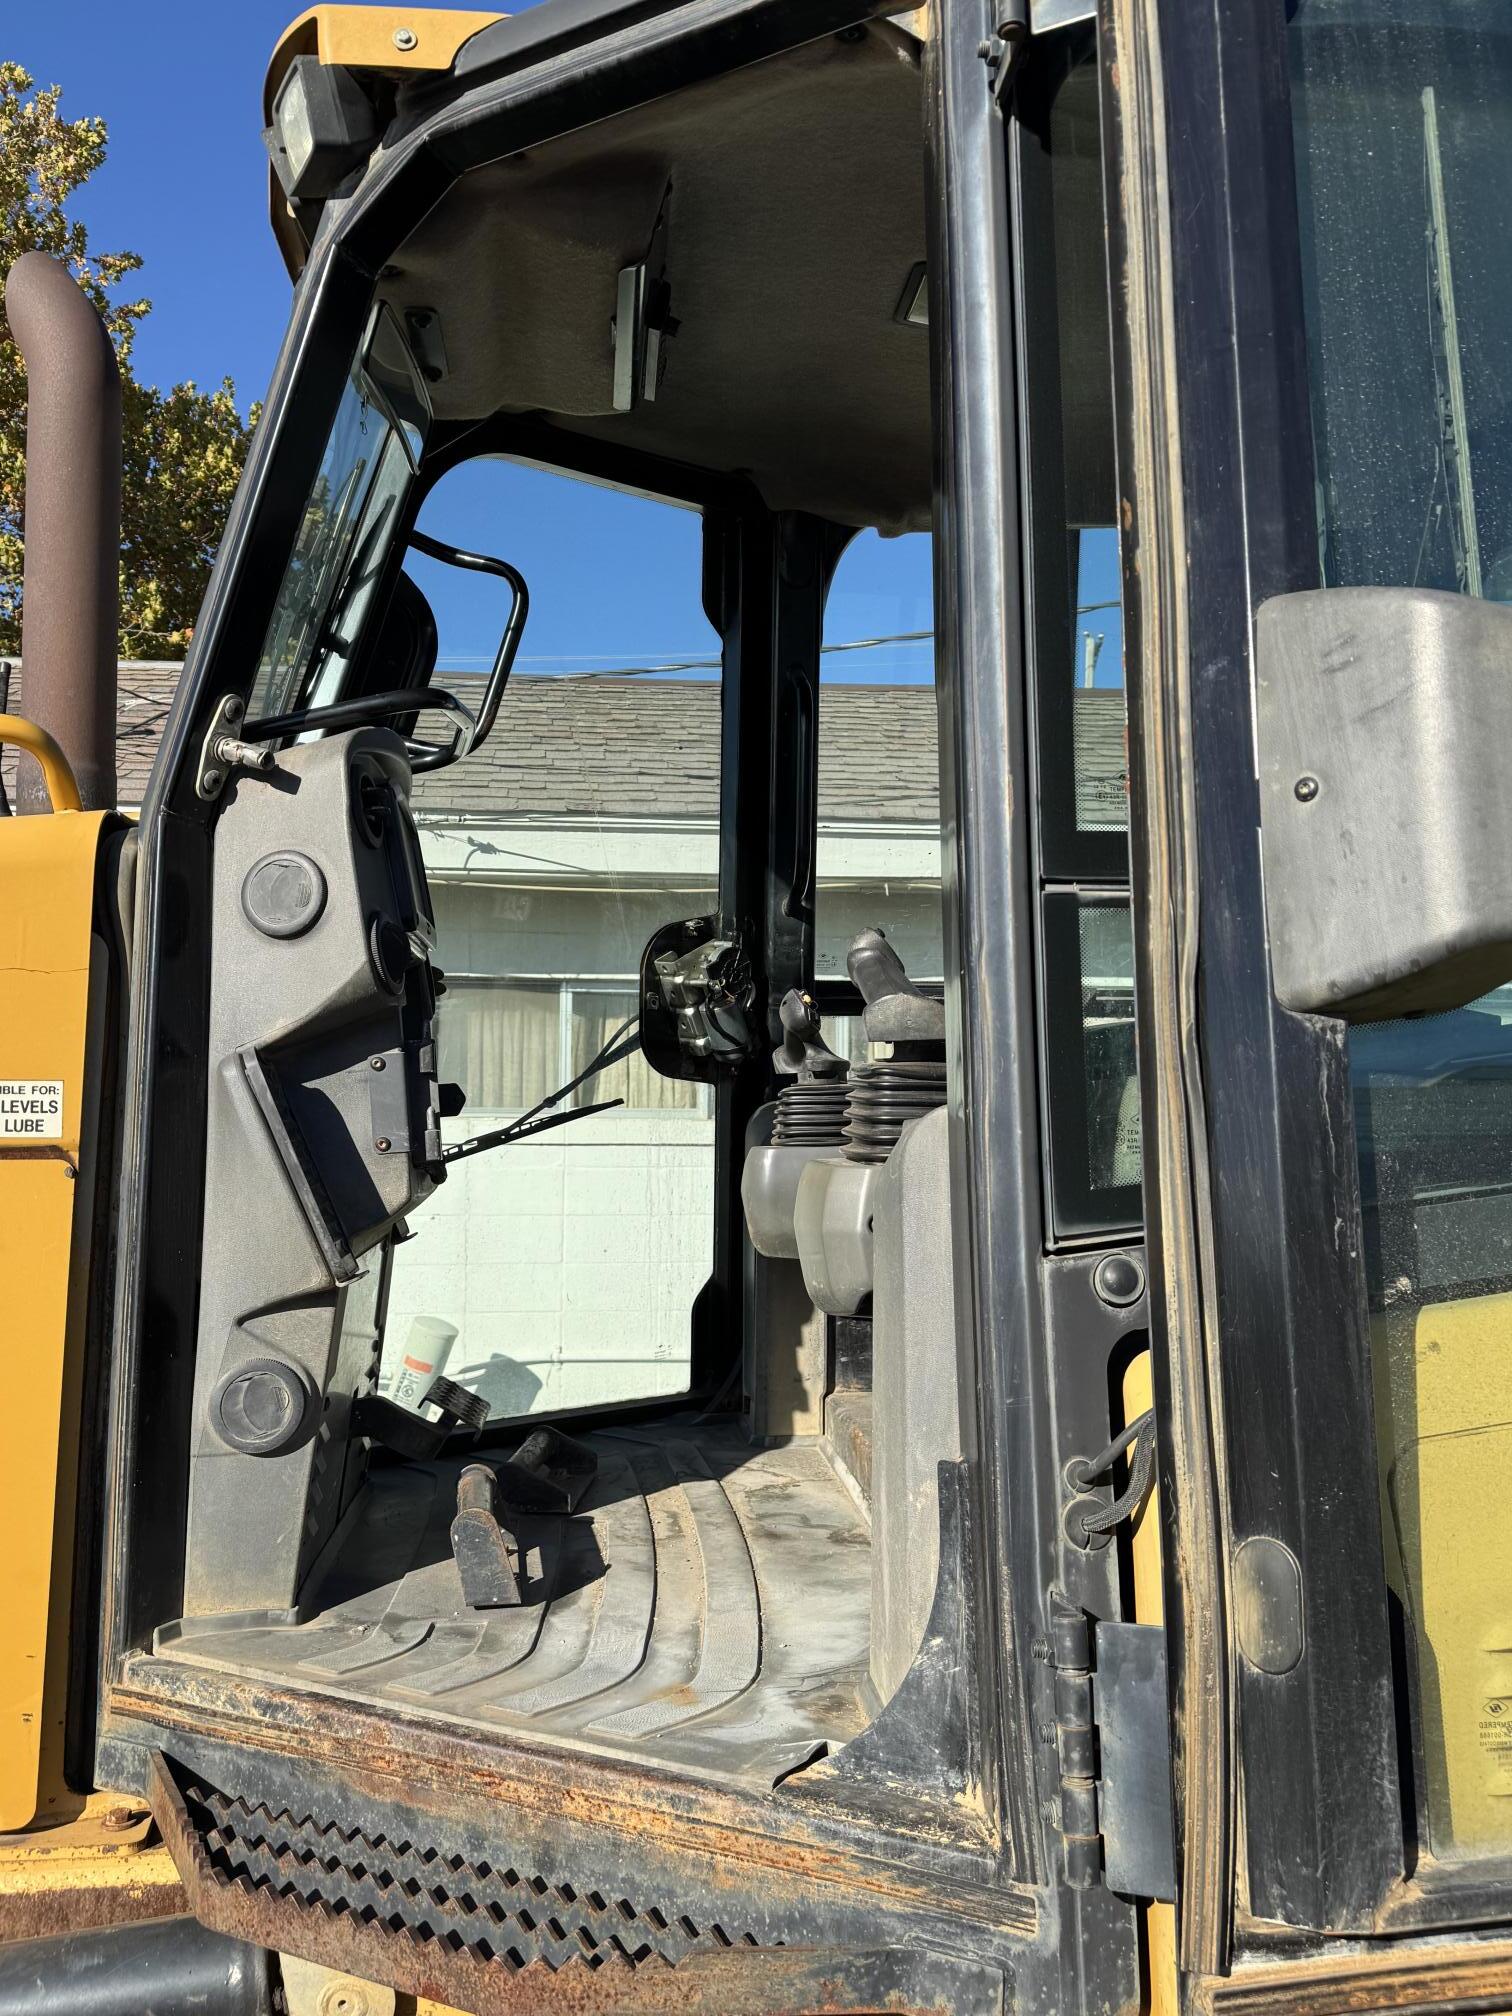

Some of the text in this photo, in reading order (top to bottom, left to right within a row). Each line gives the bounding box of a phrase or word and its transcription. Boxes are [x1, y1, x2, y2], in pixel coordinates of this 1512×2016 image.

[31, 1085, 60, 1095] FOR:
[1, 1100, 58, 1114] LEVELS
[4, 1119, 45, 1133] LUBE
